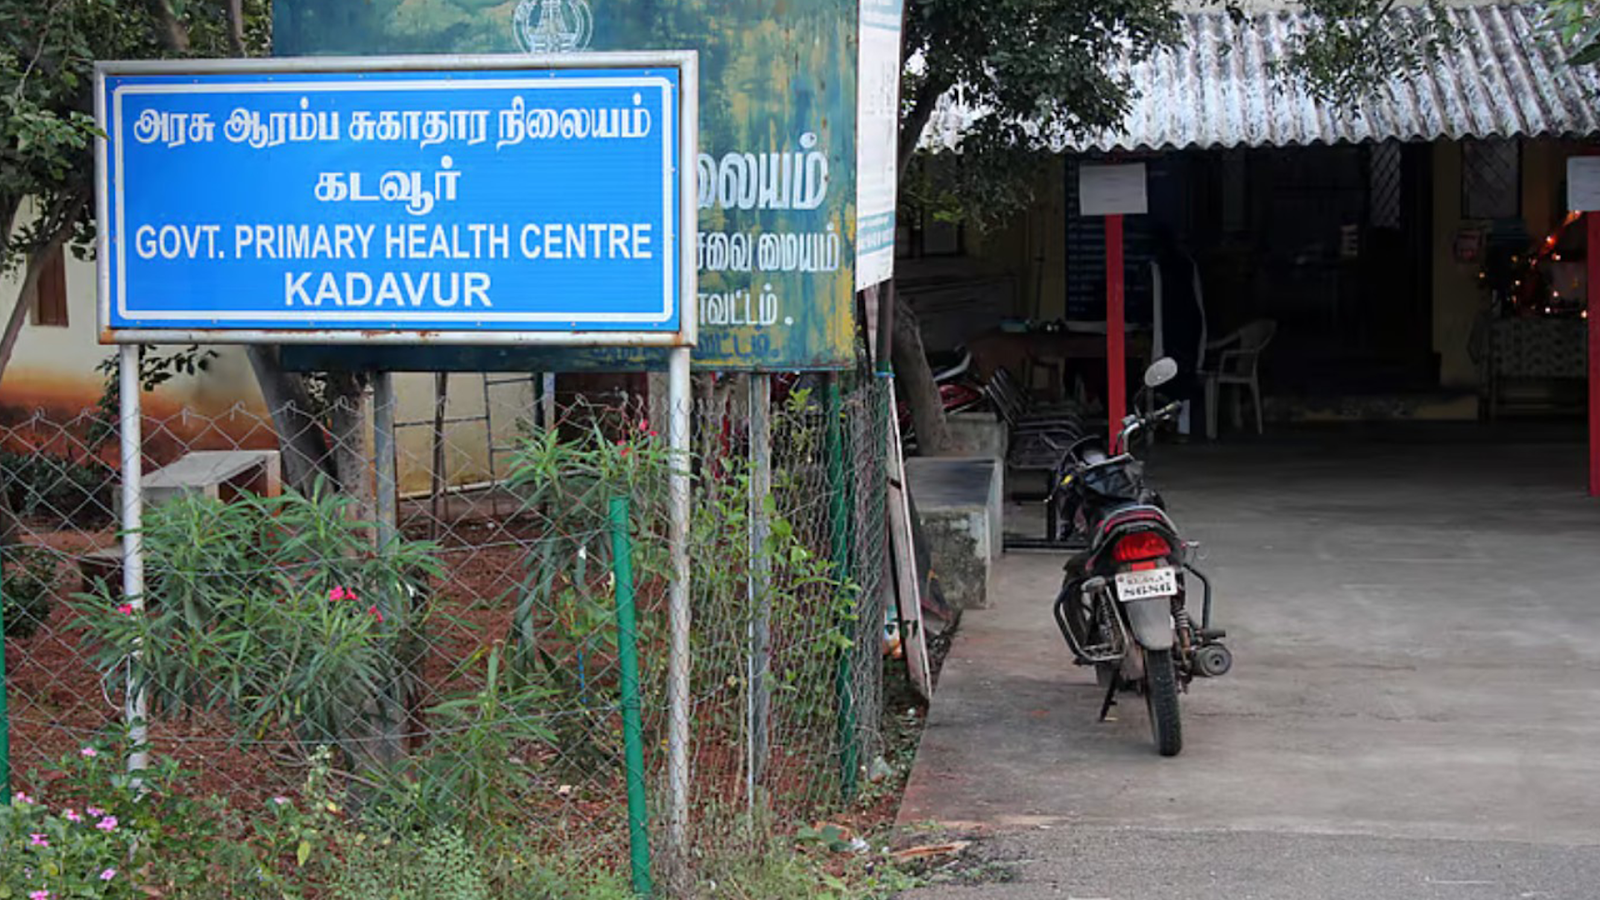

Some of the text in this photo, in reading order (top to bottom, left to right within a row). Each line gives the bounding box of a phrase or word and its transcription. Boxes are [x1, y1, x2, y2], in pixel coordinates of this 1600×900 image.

[133, 91, 651, 151] அரசு ஆரம்ப சுகாதார நிலையம்
[313, 154, 462, 216] கடவூர்
[697, 131, 829, 210] லையம்
[135, 222, 653, 260] GOVT. PRIMARY HEALTH CENTRE
[284, 271, 493, 308] KADAVUR
